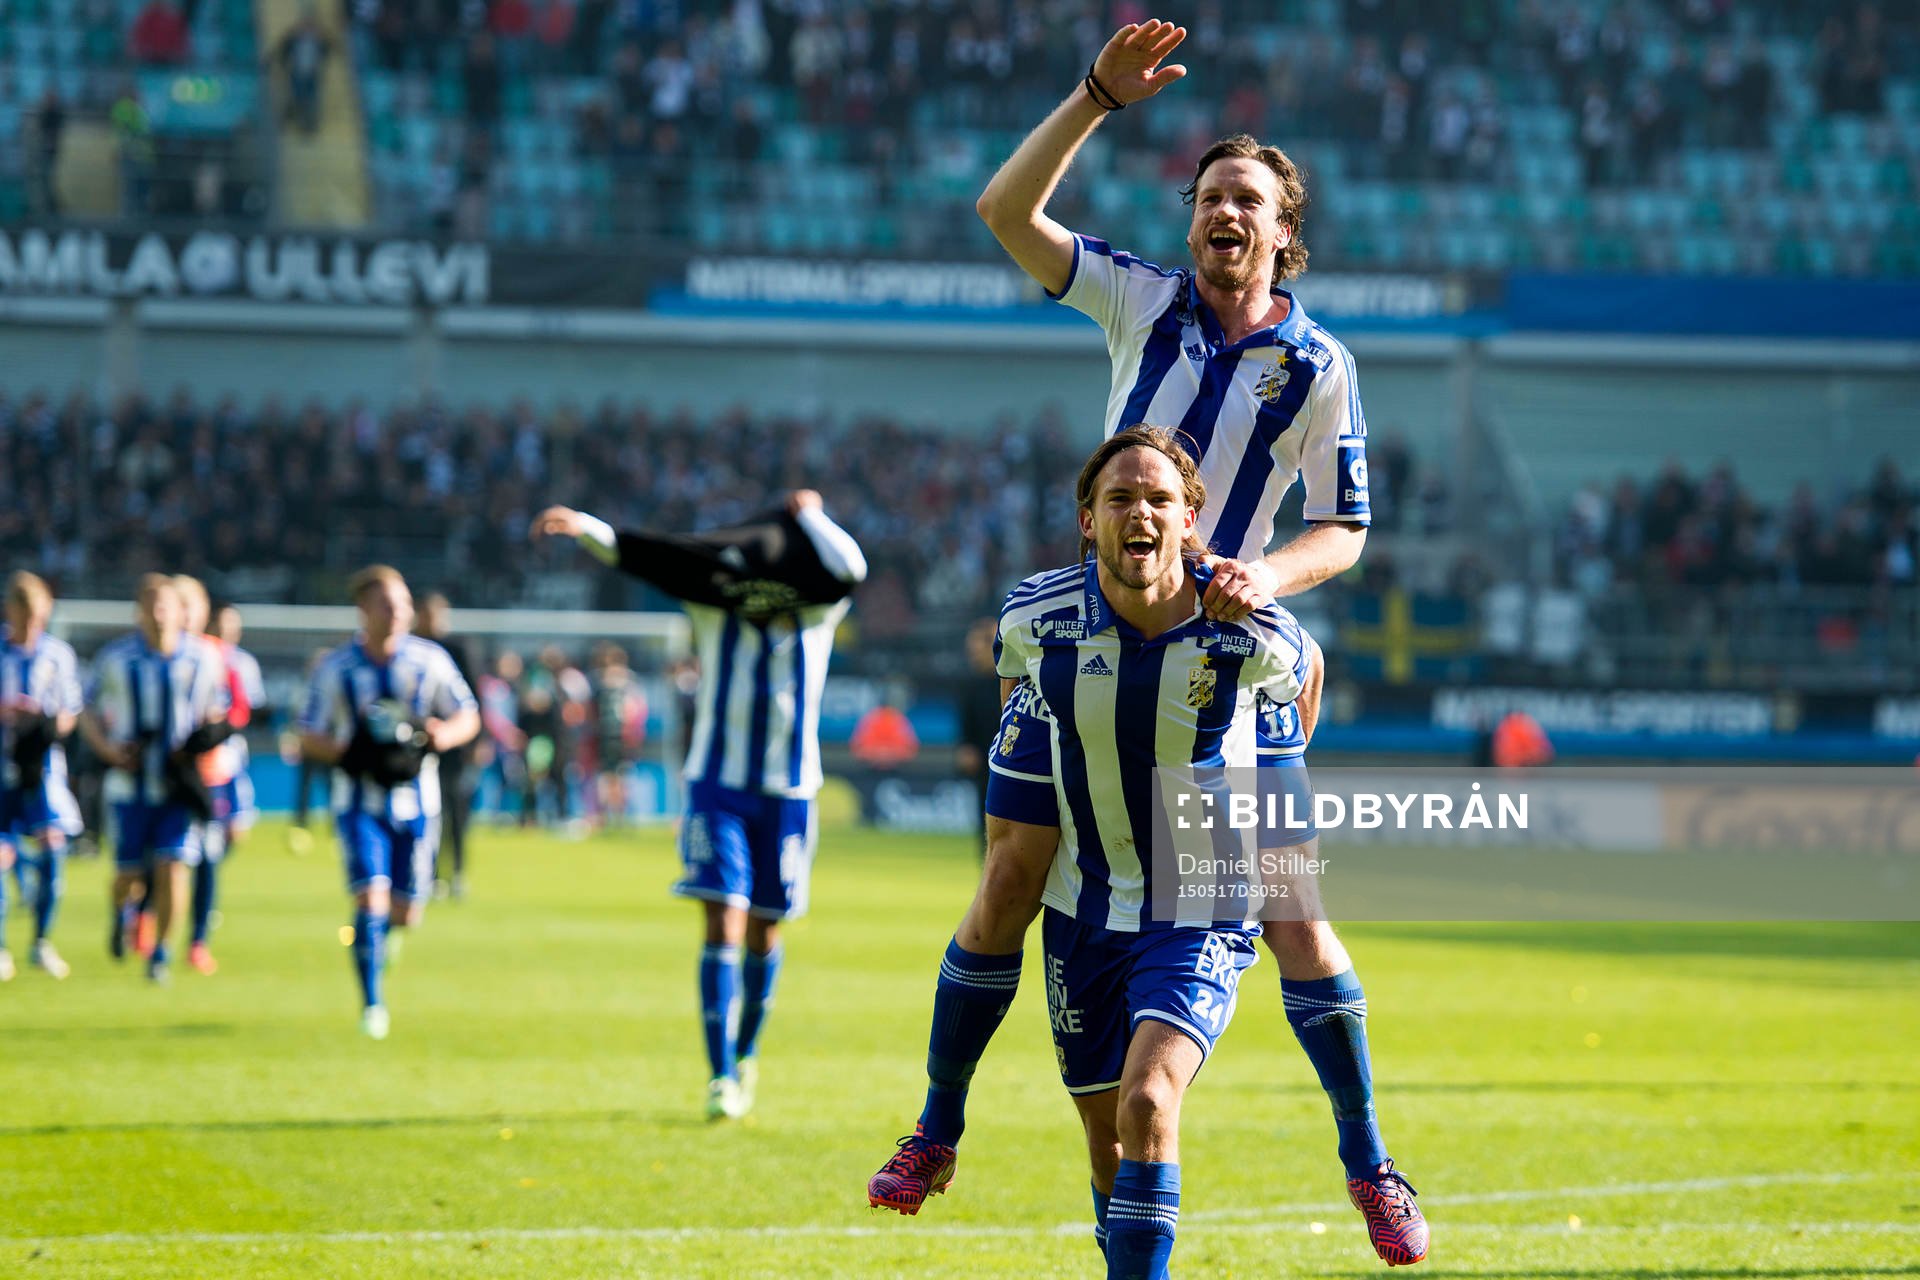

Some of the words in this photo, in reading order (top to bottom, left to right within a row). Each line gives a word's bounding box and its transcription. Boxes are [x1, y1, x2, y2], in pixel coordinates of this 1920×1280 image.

[246, 239, 491, 300] ULLEVI
[1054, 620, 1084, 630] INTER
[1054, 629, 1084, 639] SPORT
[1222, 634, 1253, 648] INTER
[1221, 643, 1252, 656] SPORT
[1080, 667, 1113, 676] adidas
[1264, 705, 1294, 739] 13
[1192, 989, 1224, 1031] 24
